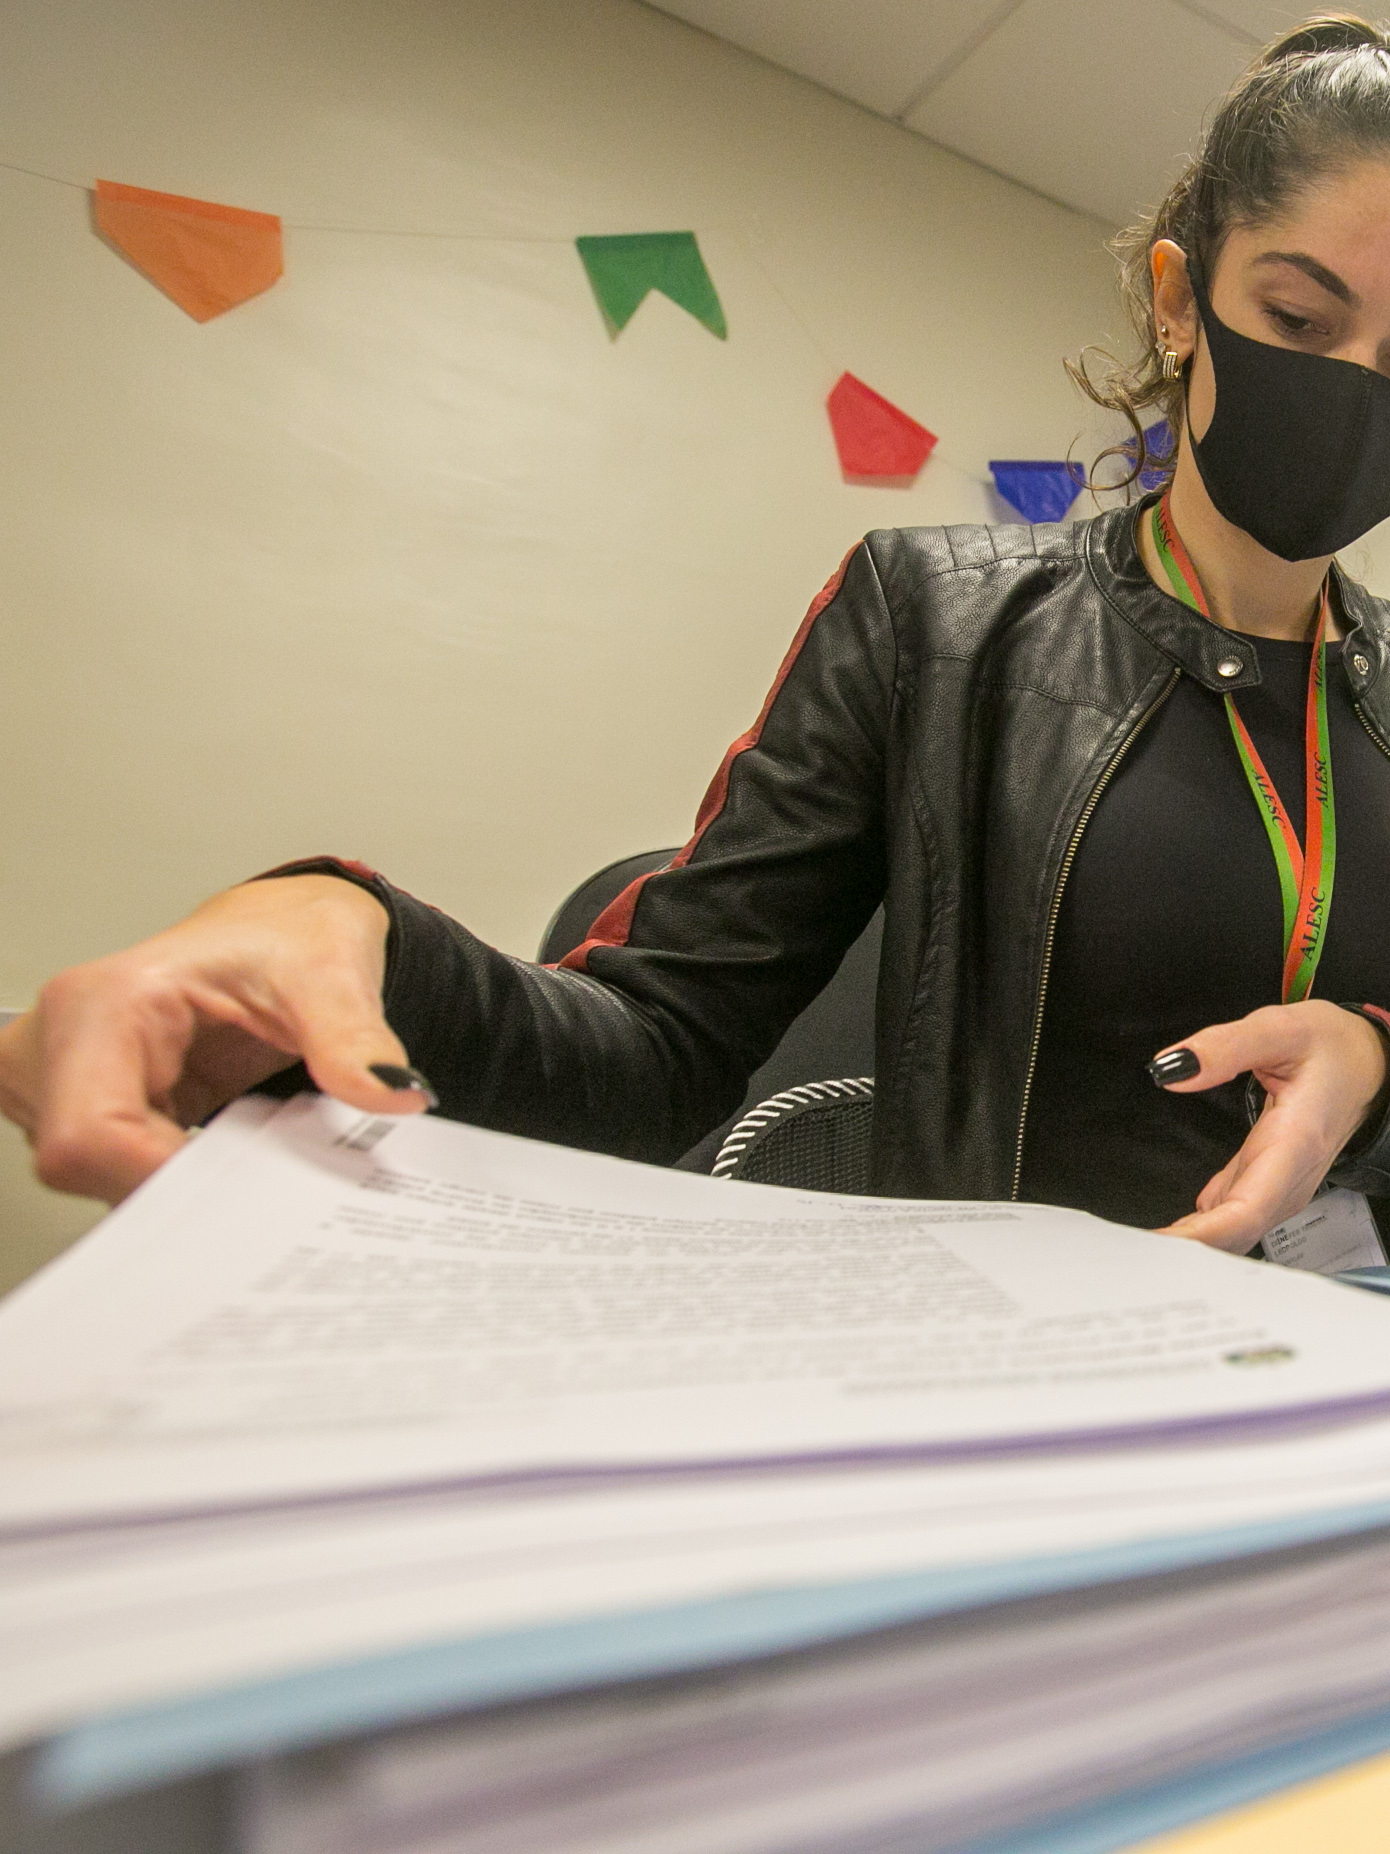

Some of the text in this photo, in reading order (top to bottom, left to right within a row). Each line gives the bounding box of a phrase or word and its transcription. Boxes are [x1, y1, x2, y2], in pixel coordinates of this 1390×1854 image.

[1251, 768, 1286, 830] ALESC
[1314, 751, 1330, 808] ALESC
[1300, 886, 1326, 962] ALESC
